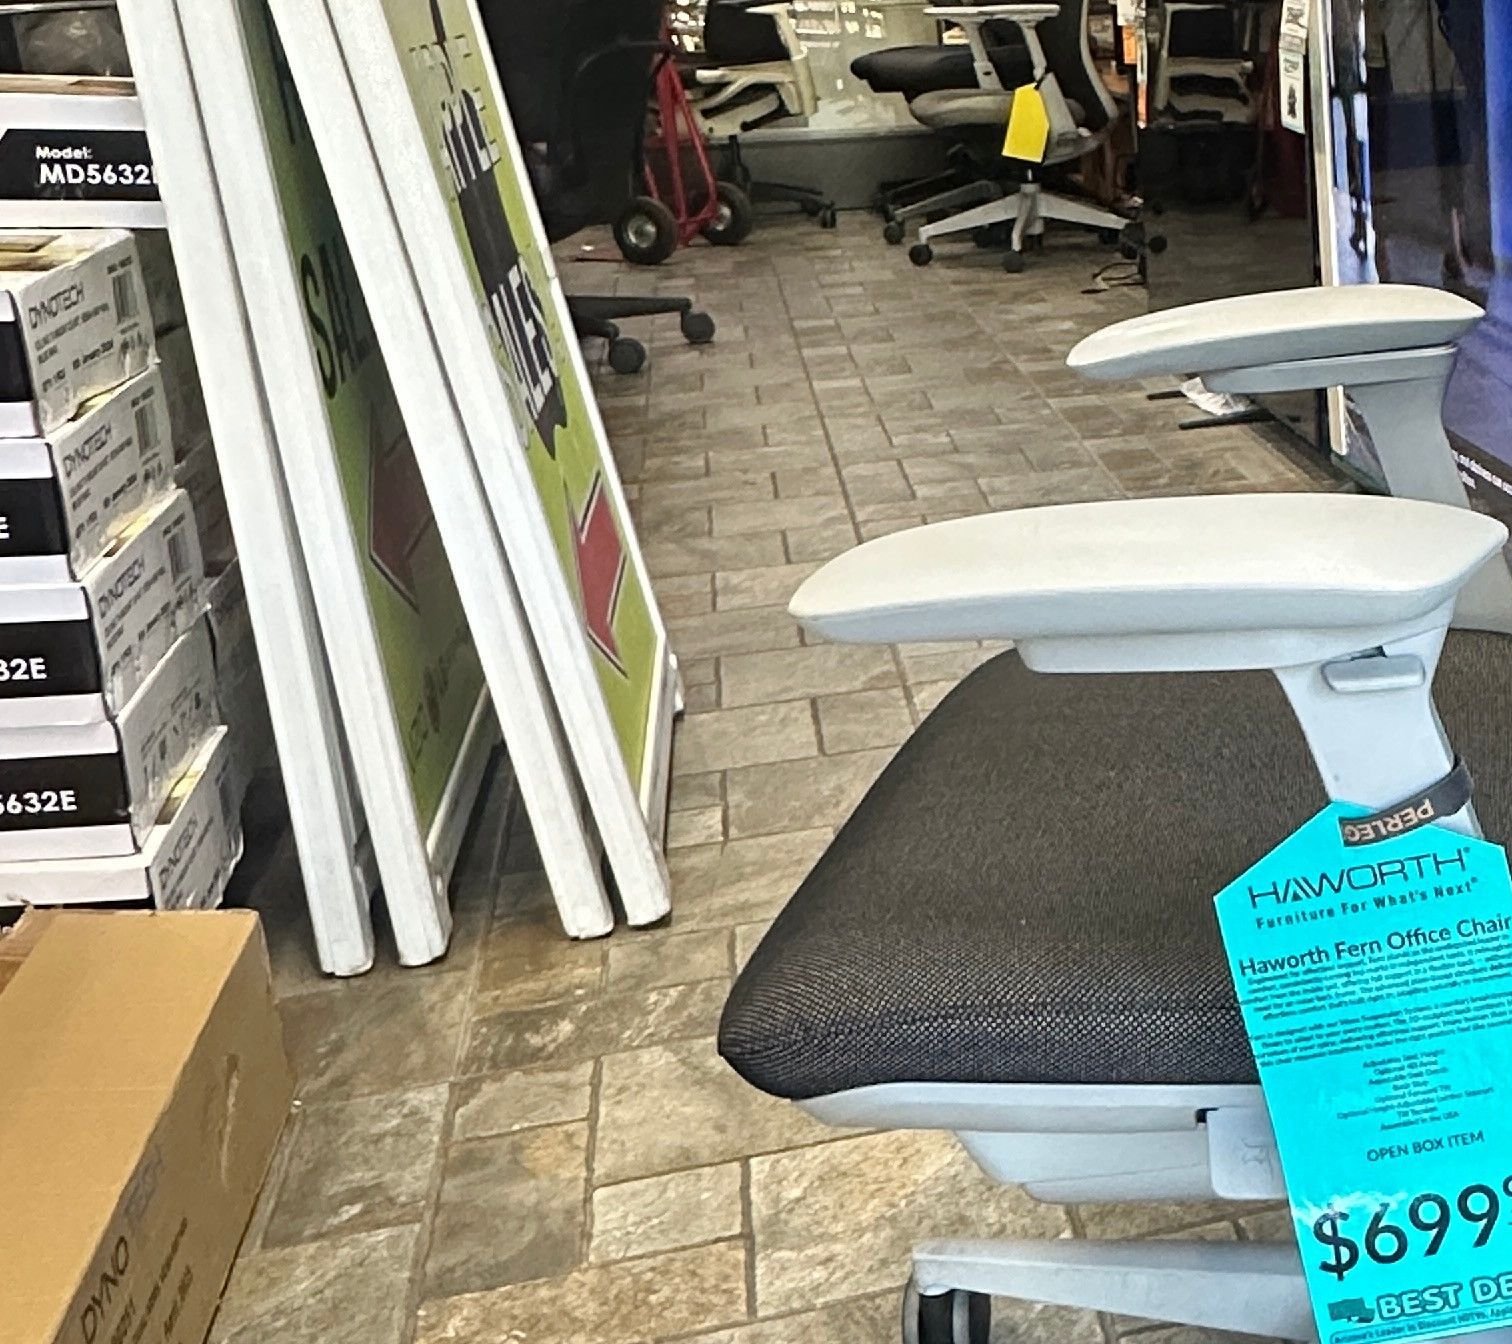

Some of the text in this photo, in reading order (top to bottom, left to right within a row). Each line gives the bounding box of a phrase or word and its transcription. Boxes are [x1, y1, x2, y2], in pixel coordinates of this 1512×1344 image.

[35, 145, 94, 160] Model:
[1247, 849, 1467, 909] HAWORTH
[1255, 904, 1336, 930] Furniture
[1340, 900, 1368, 916] For
[1373, 887, 1428, 912] What's
[1238, 912, 1512, 978] Haworth Fern Office Chair
[1366, 1129, 1486, 1163] OPEN BOX ITEM
[1377, 1283, 1462, 1321] BEST
